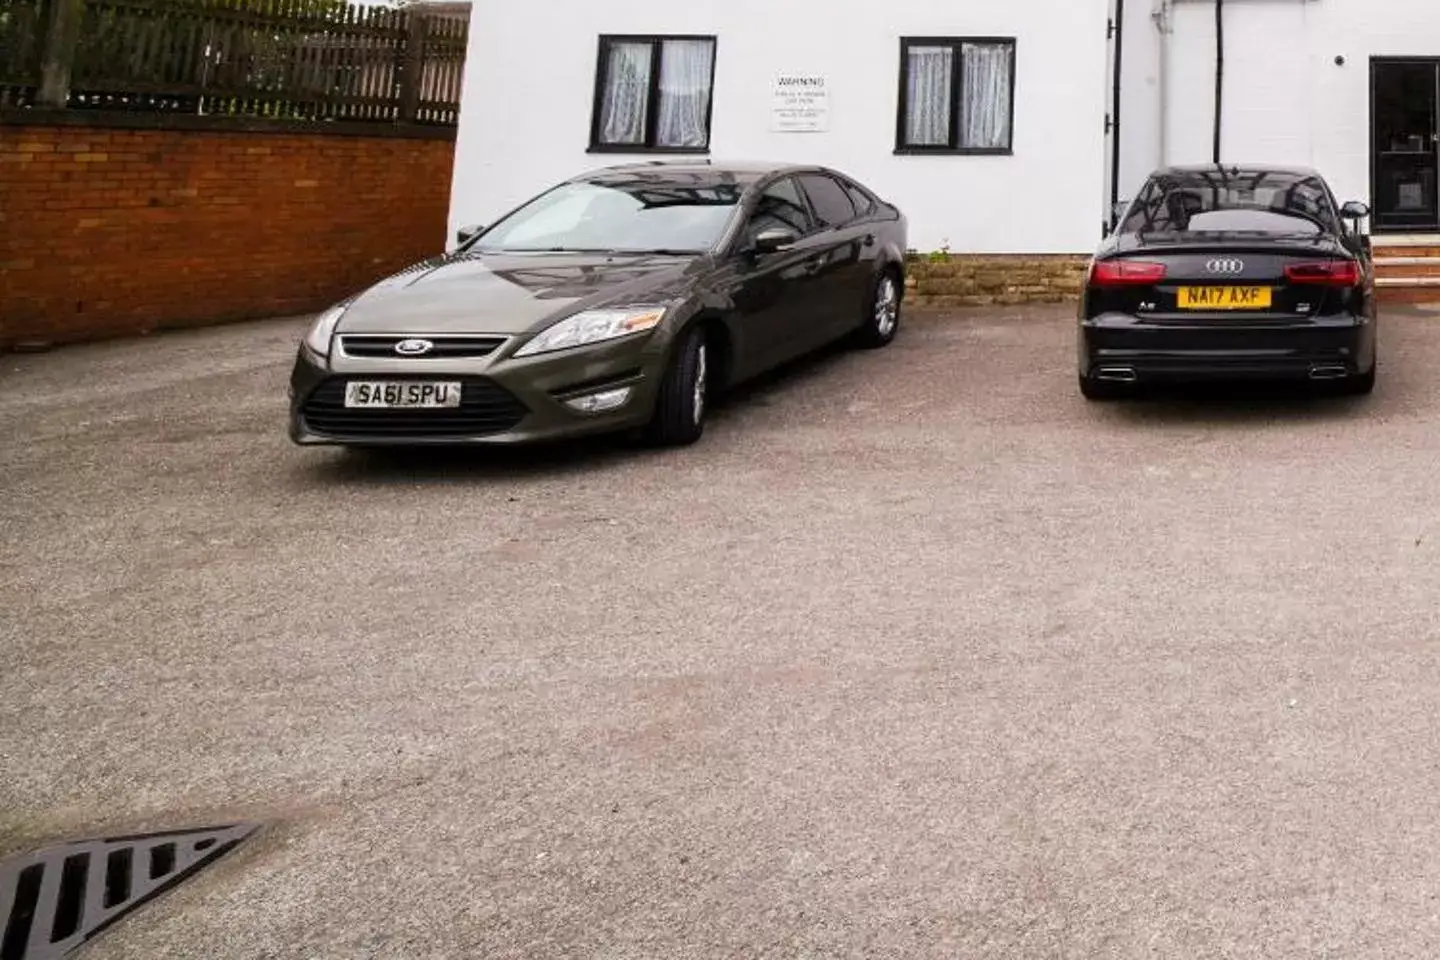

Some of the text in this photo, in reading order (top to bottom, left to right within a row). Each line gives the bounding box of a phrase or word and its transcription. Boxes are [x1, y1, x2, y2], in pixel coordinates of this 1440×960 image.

[1187, 287, 1224, 304] NA17
[358, 384, 448, 404] SA61 SPU
